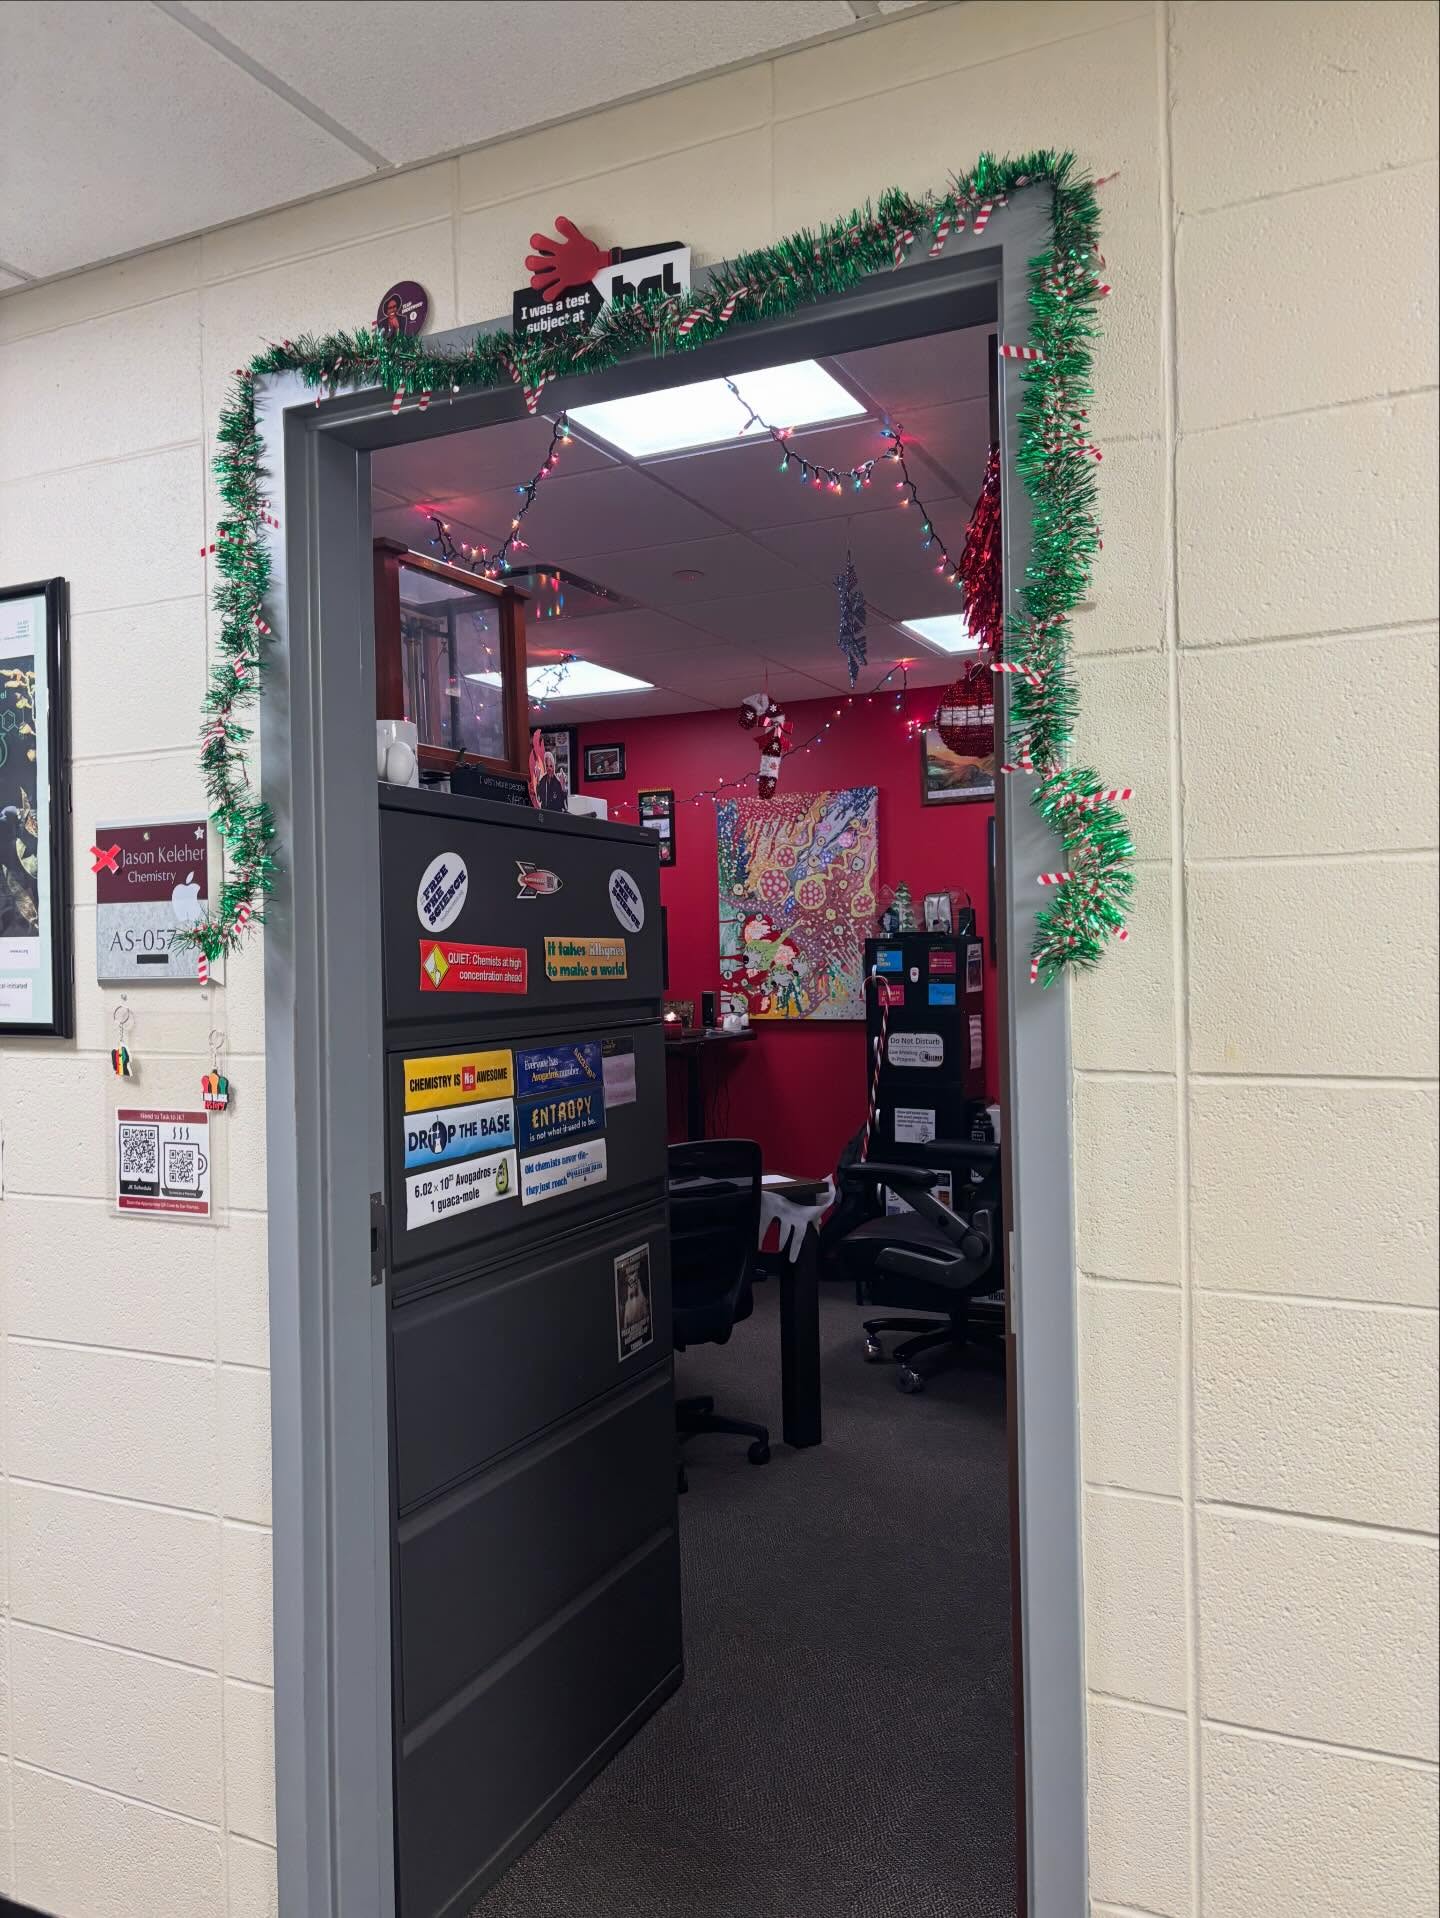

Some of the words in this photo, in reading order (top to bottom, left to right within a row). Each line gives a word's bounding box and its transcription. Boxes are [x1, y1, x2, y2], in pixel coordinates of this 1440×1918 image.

[521, 306, 528, 320] I
[529, 303, 553, 318] was
[555, 300, 563, 311] a
[565, 291, 591, 309] test
[526, 313, 570, 334] subject
[572, 309, 585, 323] at
[122, 849, 155, 868] Jason
[158, 844, 205, 863] Keleher
[127, 870, 176, 885] Chemistry
[423, 864, 448, 901] FREE
[423, 886, 445, 914] THE
[428, 870, 467, 926] SCIENCE
[614, 879, 629, 902] THE
[619, 876, 638, 904] FREE
[611, 887, 641, 929] SCIENCE
[547, 941, 556, 956] It
[558, 941, 586, 956] takes
[448, 952, 471, 966] QUIET:
[472, 954, 501, 967] Chemists
[502, 958, 509, 967] at
[509, 957, 522, 970] high
[547, 961, 558, 976] to
[559, 961, 589, 976] make
[591, 966, 598, 976] a
[600, 961, 625, 976] world
[459, 970, 503, 981] concentration
[504, 972, 523, 983] ahead
[901, 1037, 914, 1045] Not
[915, 1037, 940, 1045] Disturb
[524, 1058, 548, 1071] Everyone
[409, 1074, 451, 1092] CHEMISTRY
[453, 1073, 461, 1086] IS
[464, 1072, 474, 1085] Na
[476, 1067, 508, 1083] AWESOME
[531, 1095, 592, 1129] ENTROPY
[408, 1120, 457, 1154] DROP
[459, 1121, 478, 1139] THE
[480, 1113, 510, 1137] BASE
[529, 1132, 535, 1142] is
[536, 1130, 546, 1140] not
[547, 1127, 562, 1137] what
[562, 1124, 567, 1133] it
[567, 1120, 581, 1132] used
[581, 1119, 587, 1127] to
[524, 1164, 534, 1174] Old
[535, 1157, 561, 1172] chemists
[562, 1153, 577, 1165] never
[414, 1182, 433, 1198] 6.02
[455, 1166, 491, 1187] Avogadros
[526, 1183, 540, 1196] they
[539, 1180, 551, 1194] just
[551, 1176, 568, 1189] reach
[430, 1200, 435, 1212] 1
[437, 1187, 480, 1213] guaca-mole
